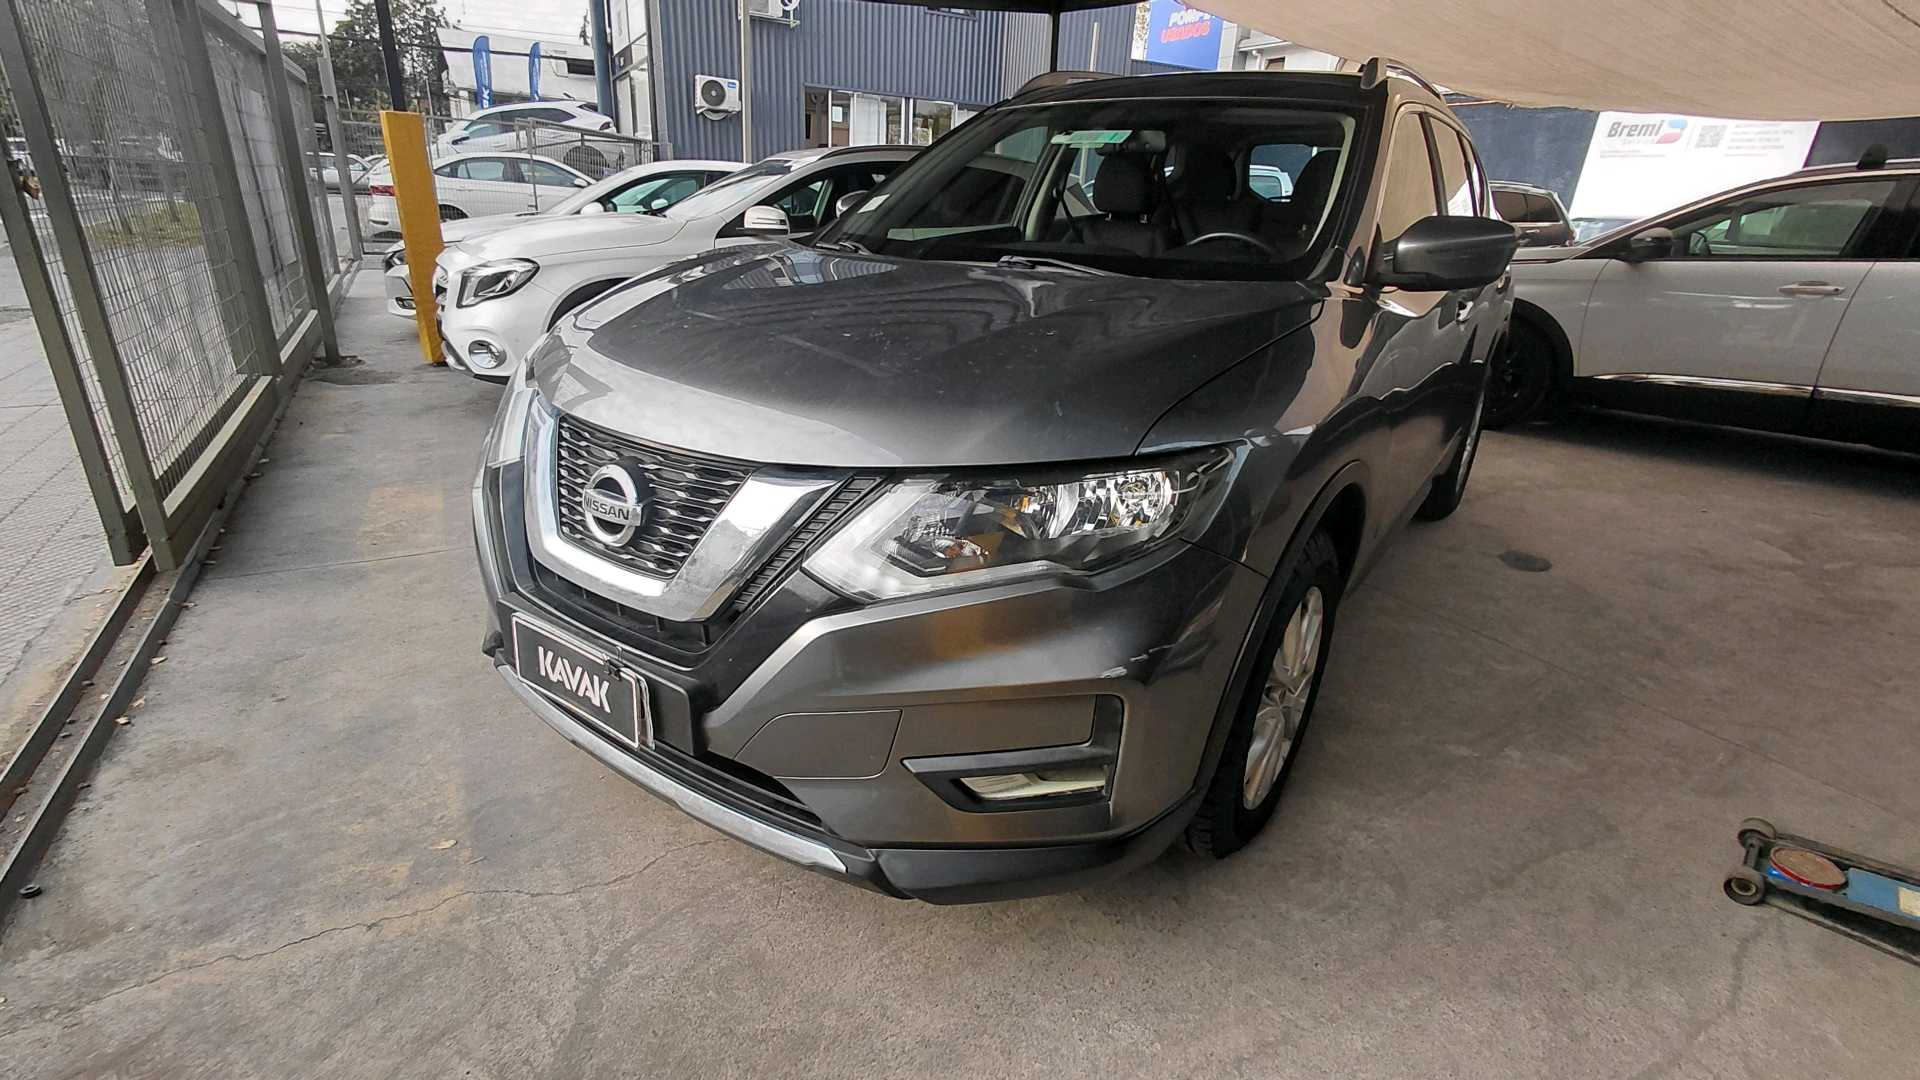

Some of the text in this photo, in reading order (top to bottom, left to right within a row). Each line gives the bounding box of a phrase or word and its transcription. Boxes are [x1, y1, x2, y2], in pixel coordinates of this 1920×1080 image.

[1607, 119, 1665, 137] Bremi
[584, 497, 630, 521] NISSAN
[537, 645, 612, 714] KAVAK
